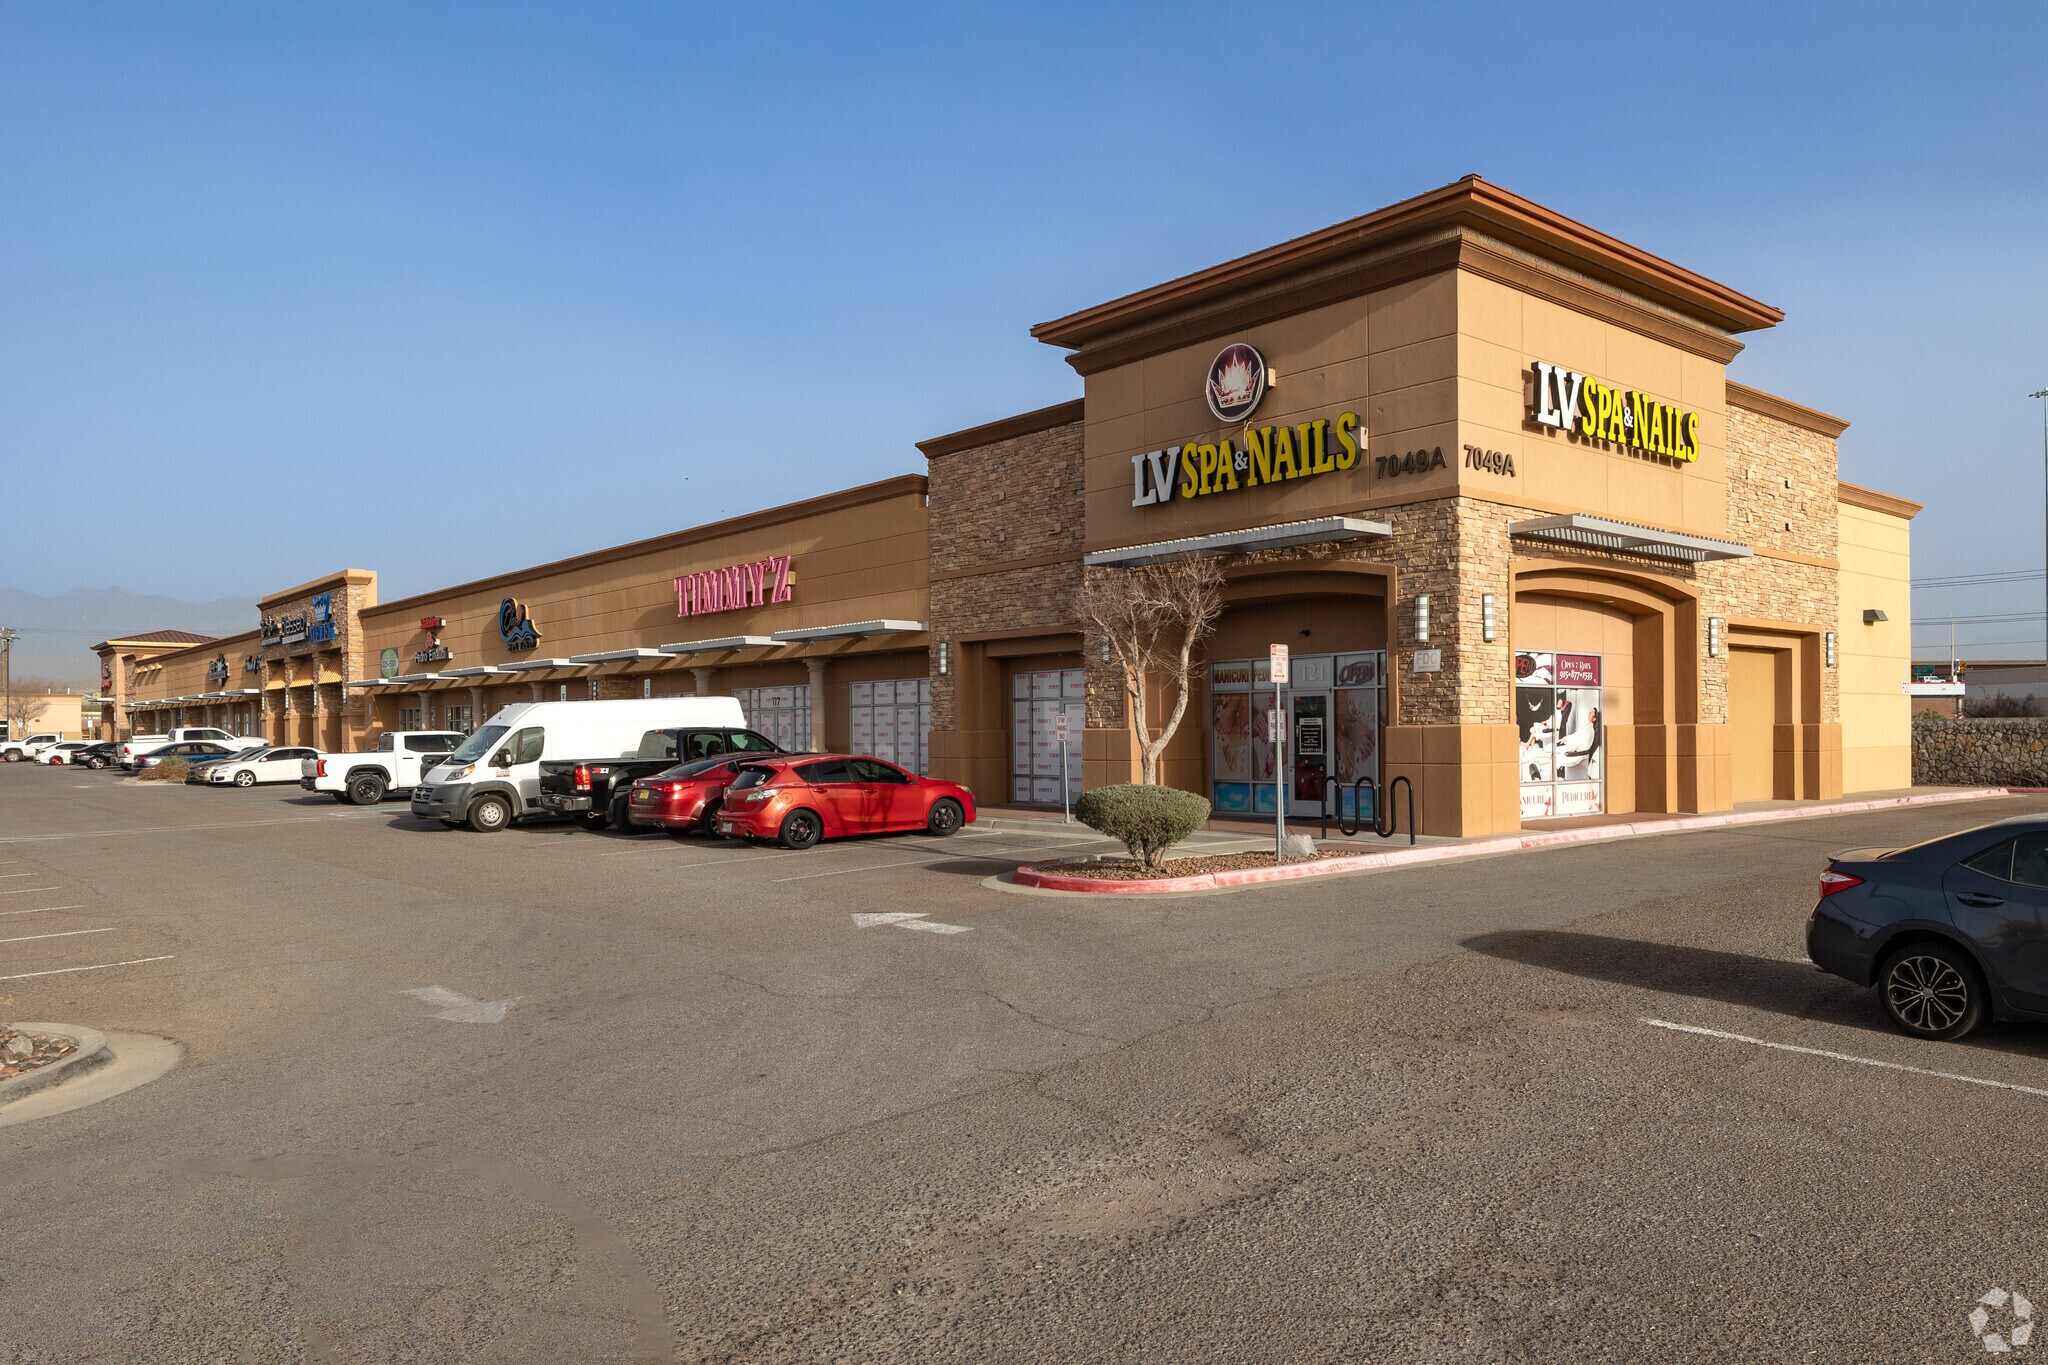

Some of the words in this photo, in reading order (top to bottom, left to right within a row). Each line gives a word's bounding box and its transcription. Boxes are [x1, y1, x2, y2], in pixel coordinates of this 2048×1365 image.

[1536, 361, 1583, 430] LV
[1583, 375, 1627, 445] SPA
[1632, 392, 1699, 463] NAILS
[1131, 445, 1181, 507] LV
[1182, 440, 1239, 499] SPA
[1246, 412, 1358, 487] NAILS
[1375, 446, 1448, 480] 7049A
[1463, 444, 1516, 478] 7049A
[673, 555, 791, 617] TIMMY'Z
[1302, 663, 1325, 680] 121
[1416, 652, 1438, 665] FDC
[1516, 655, 1535, 674] PEN
